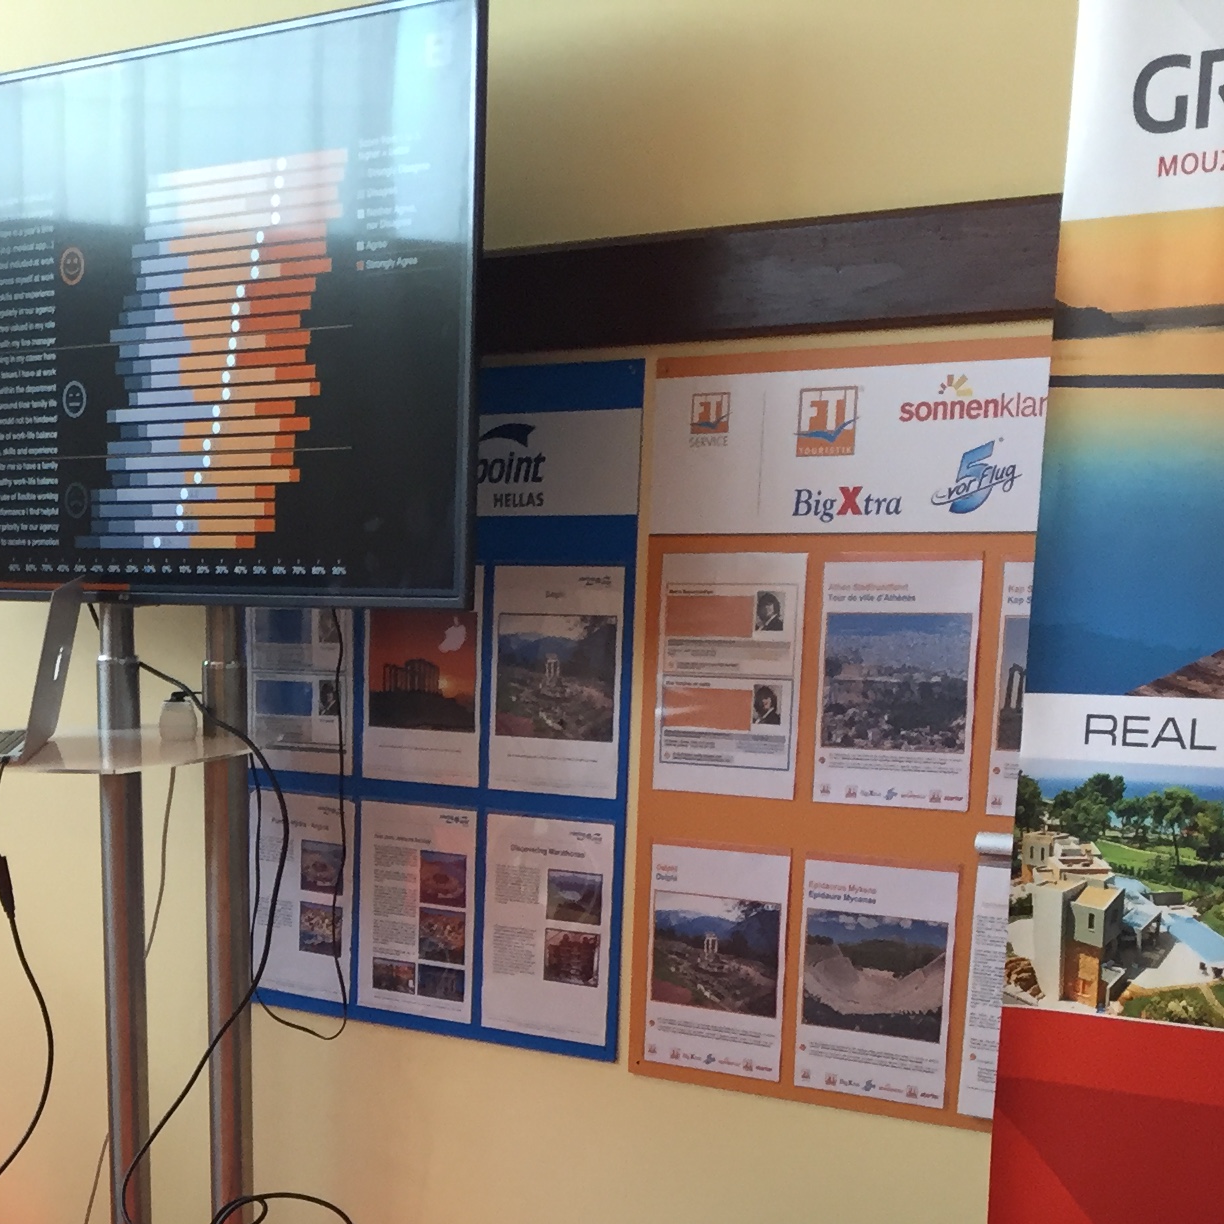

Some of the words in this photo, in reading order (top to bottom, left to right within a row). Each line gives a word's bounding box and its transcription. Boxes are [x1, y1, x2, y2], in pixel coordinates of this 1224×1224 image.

[1157, 150, 1224, 178] MOU
[689, 435, 729, 448] SERVICE
[493, 492, 545, 508] HELLAS
[792, 485, 902, 524] BigXtra
[1084, 713, 1218, 751] REAL
